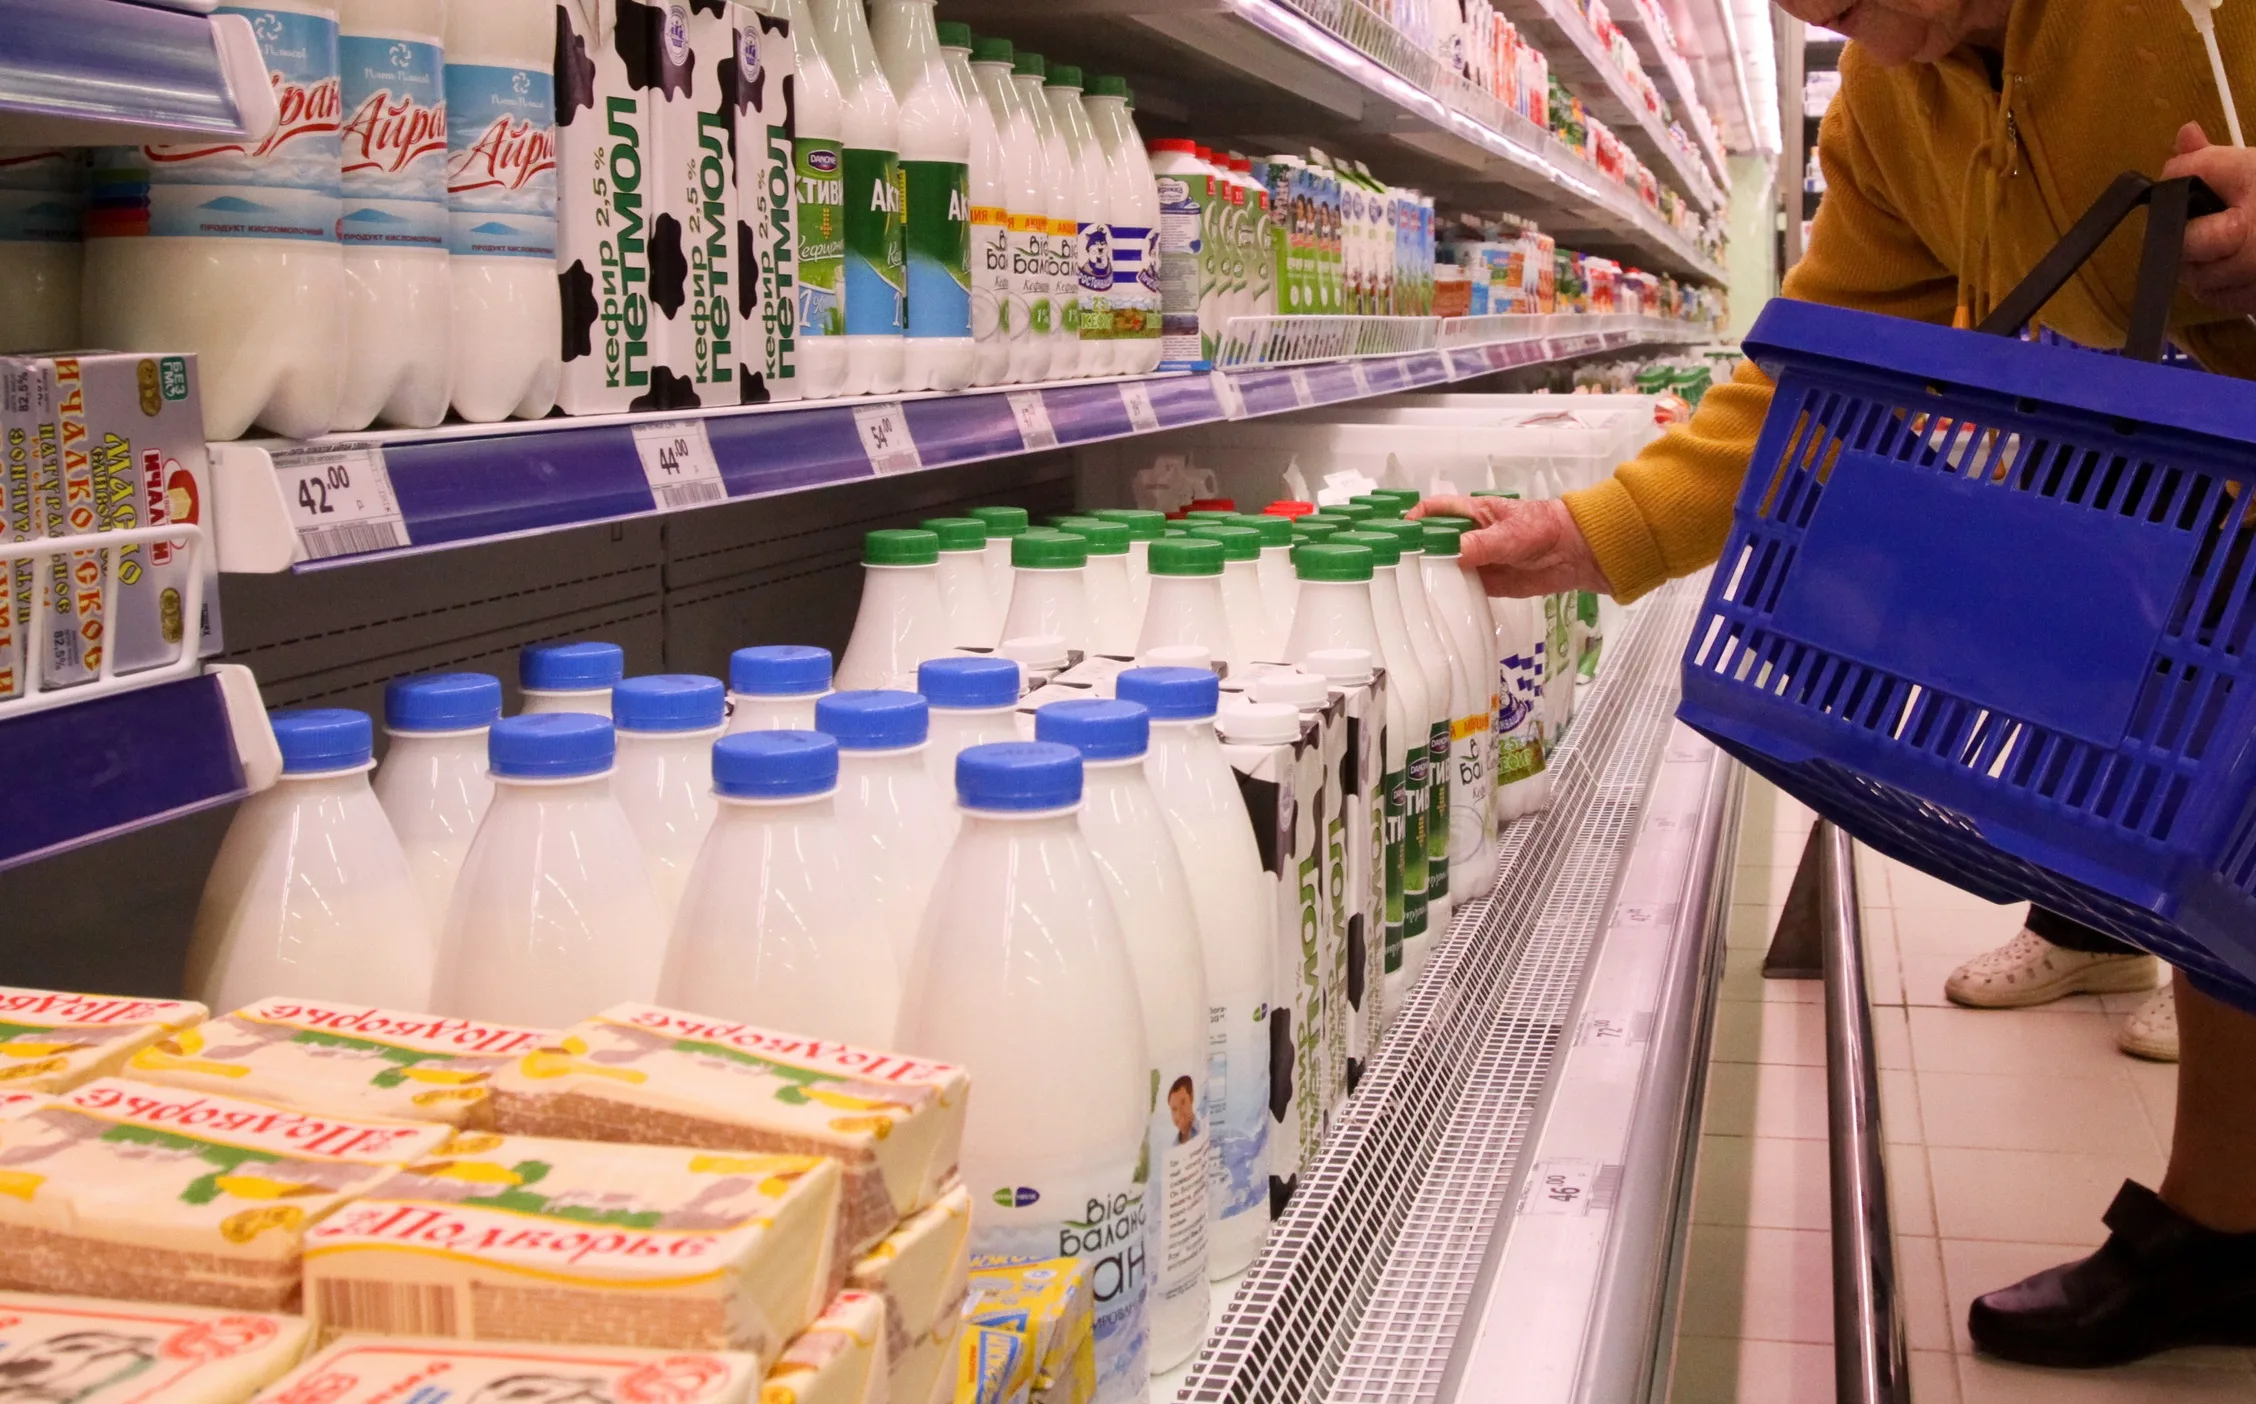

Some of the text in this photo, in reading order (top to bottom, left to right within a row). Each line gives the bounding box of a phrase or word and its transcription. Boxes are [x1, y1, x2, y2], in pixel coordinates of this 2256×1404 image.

[341, 93, 447, 172] Айра
[450, 116, 556, 189] Айра
[200, 223, 245, 233] ПРОДУКТ
[343, 233, 383, 242] ПРОДУКТ
[600, 240, 623, 388] кефир
[691, 245, 711, 384] кефир
[761, 250, 777, 380] кефир
[173, 361, 186, 395] БЕЗ
[38, 422, 72, 615] НАТУРАЬНОЕ
[144, 453, 171, 560] ИЧАЛИ
[1500, 748, 1533, 774] ЕФИР
[74, 1089, 419, 1157] Подворье
[314, 1205, 718, 1263] Подворье
[1093, 1241, 1146, 1302] ан
